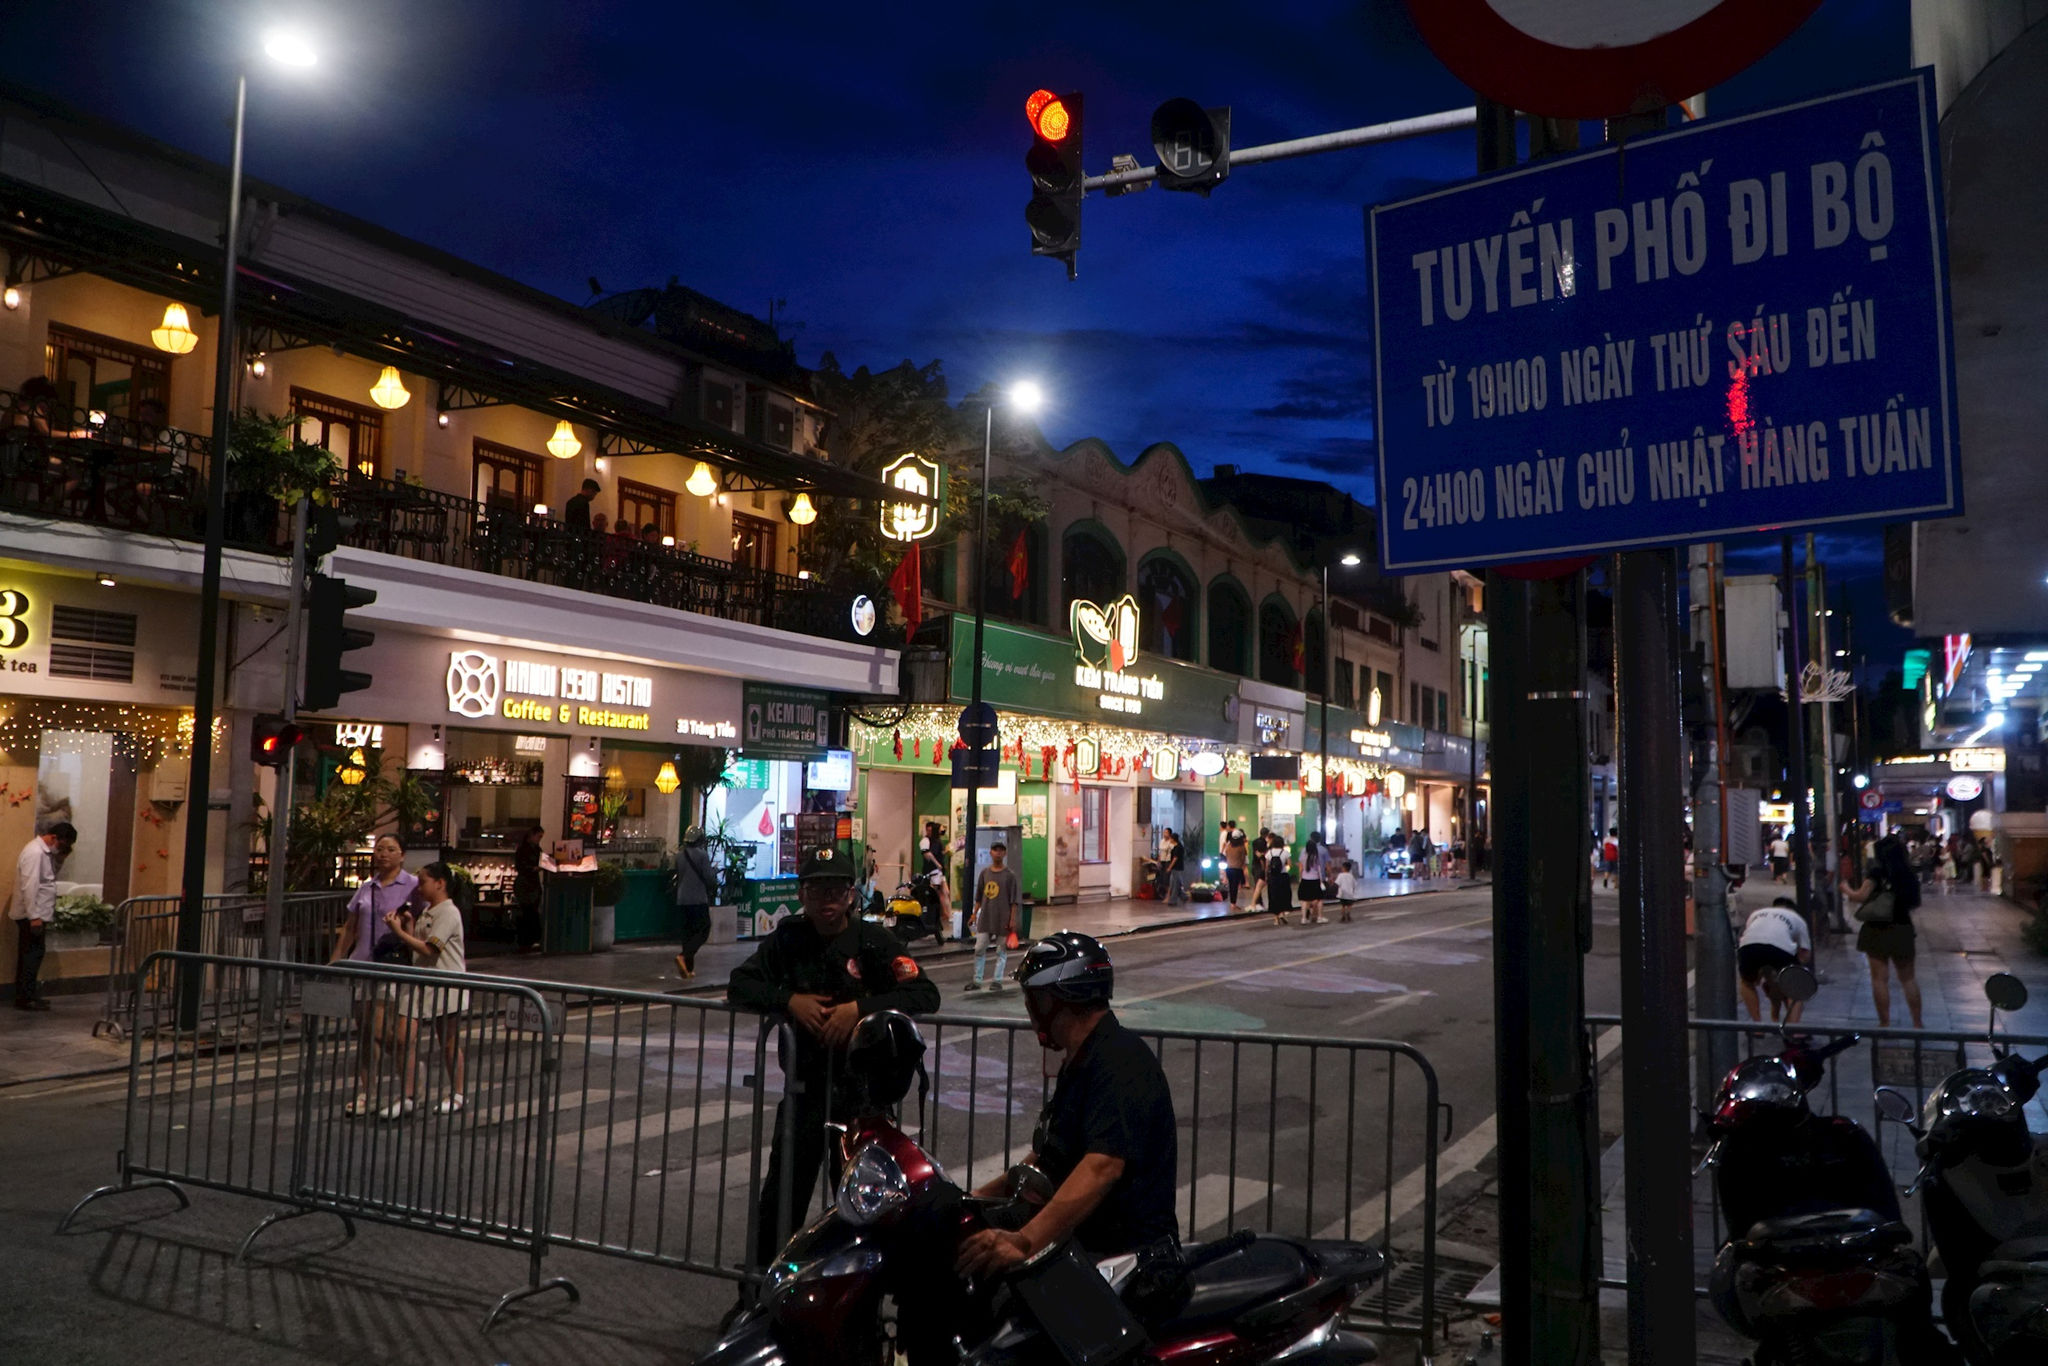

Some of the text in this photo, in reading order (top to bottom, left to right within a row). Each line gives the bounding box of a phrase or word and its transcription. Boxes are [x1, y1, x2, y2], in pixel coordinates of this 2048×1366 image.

[1411, 131, 1896, 326] TUYẾN PHỐ ĐI BỘ
[1422, 286, 1877, 427] TỪ 19H00 NGÀY THỨ SÁU ĐẾN
[1402, 393, 1932, 531] 24H00 NGÀY CHỦ NHẬT HÀNG TUẦN
[11, 659, 37, 673] tea
[505, 660, 652, 708] HANOI 1930 BISTRO
[1075, 665, 1102, 690] KEM
[1103, 669, 1140, 696] TRÀNG
[503, 698, 650, 730] Coffee & Restaurant
[767, 702, 795, 724] KEM
